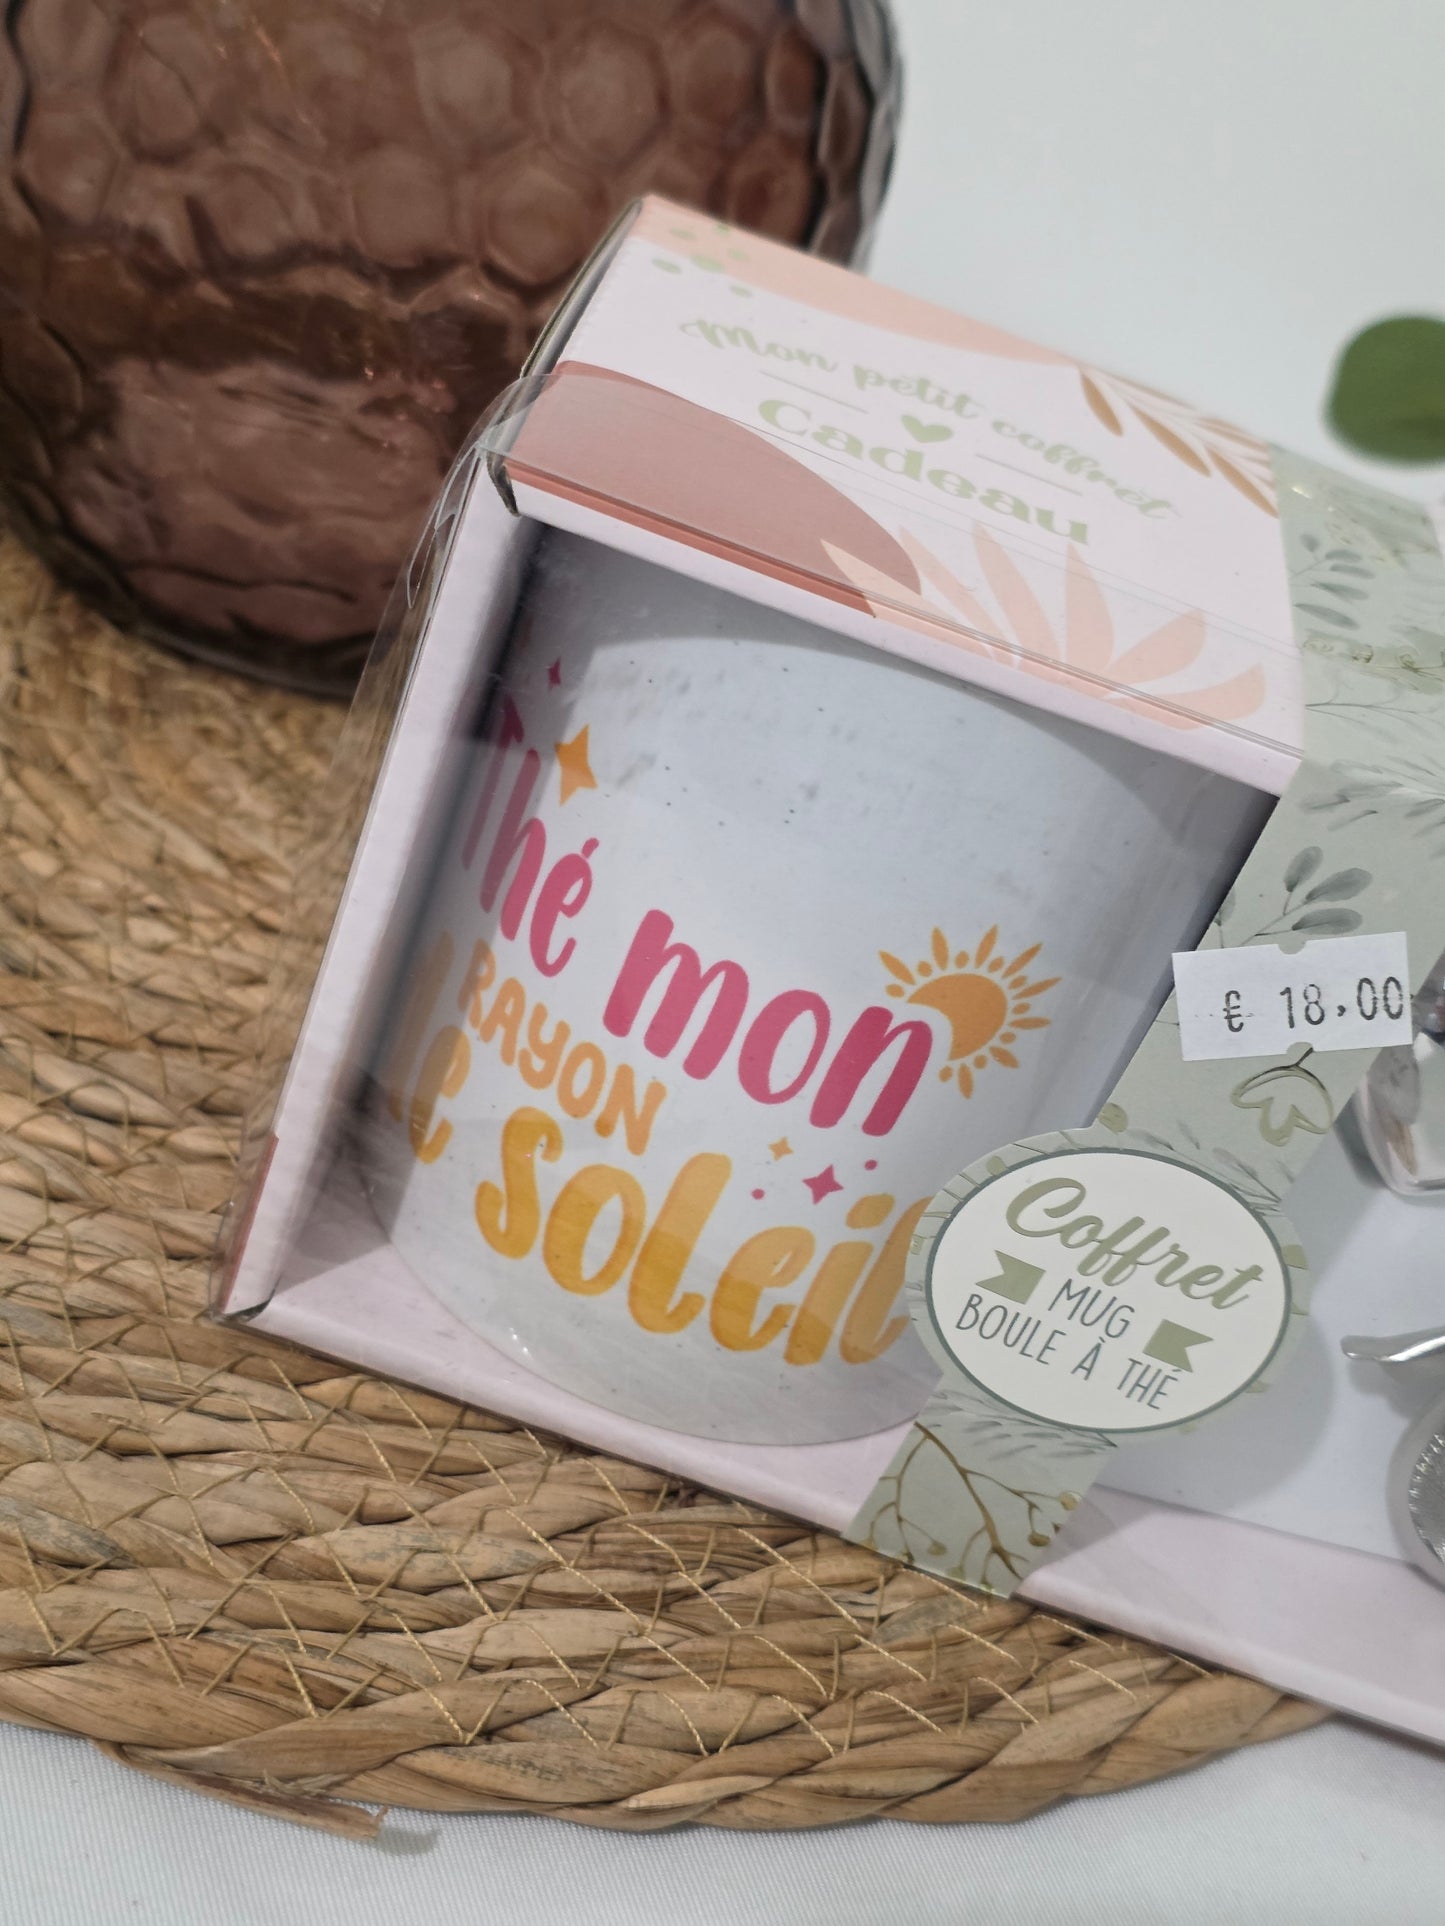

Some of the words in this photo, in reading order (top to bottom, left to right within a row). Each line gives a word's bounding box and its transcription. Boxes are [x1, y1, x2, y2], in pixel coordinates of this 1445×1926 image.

[678, 318, 839, 373] Mon
[757, 397, 1090, 546] Cadeau
[456, 937, 668, 1157] RAYON
[602, 908, 934, 1137] mon
[1222, 989, 1245, 1033] €
[1005, 1177, 1264, 1310] Coffret
[955, 1292, 1067, 1366] BOULE
[1071, 1335, 1104, 1382] À
[1116, 1357, 1183, 1411] THÉ
[1047, 1278, 1136, 1339] MUG
